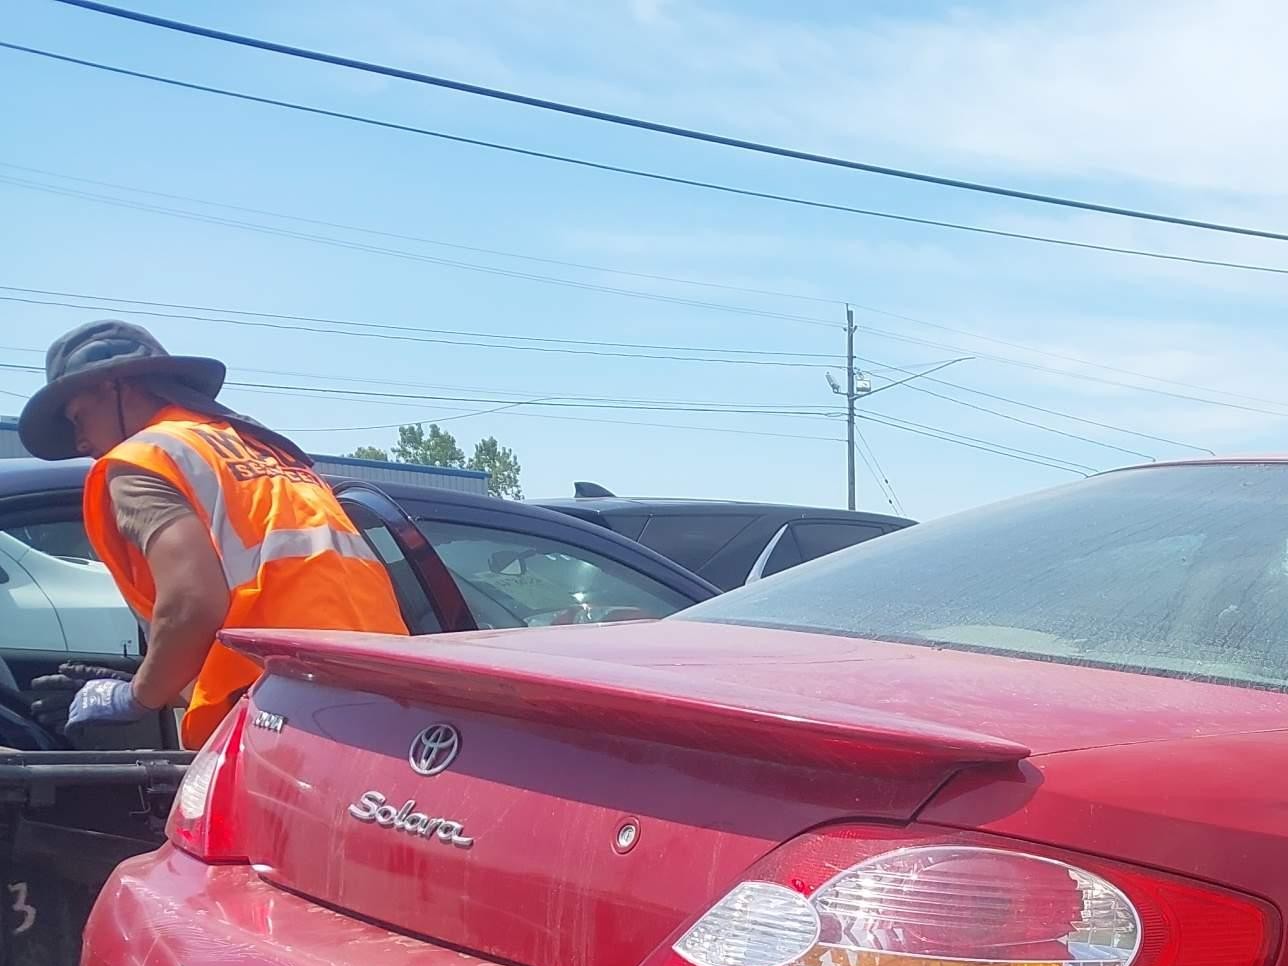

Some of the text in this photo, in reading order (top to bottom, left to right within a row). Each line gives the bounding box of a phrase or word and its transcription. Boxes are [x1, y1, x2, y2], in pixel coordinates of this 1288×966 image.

[234, 462, 315, 484] SECE
[347, 790, 474, 849] Solara
[8, 881, 37, 935] 3
